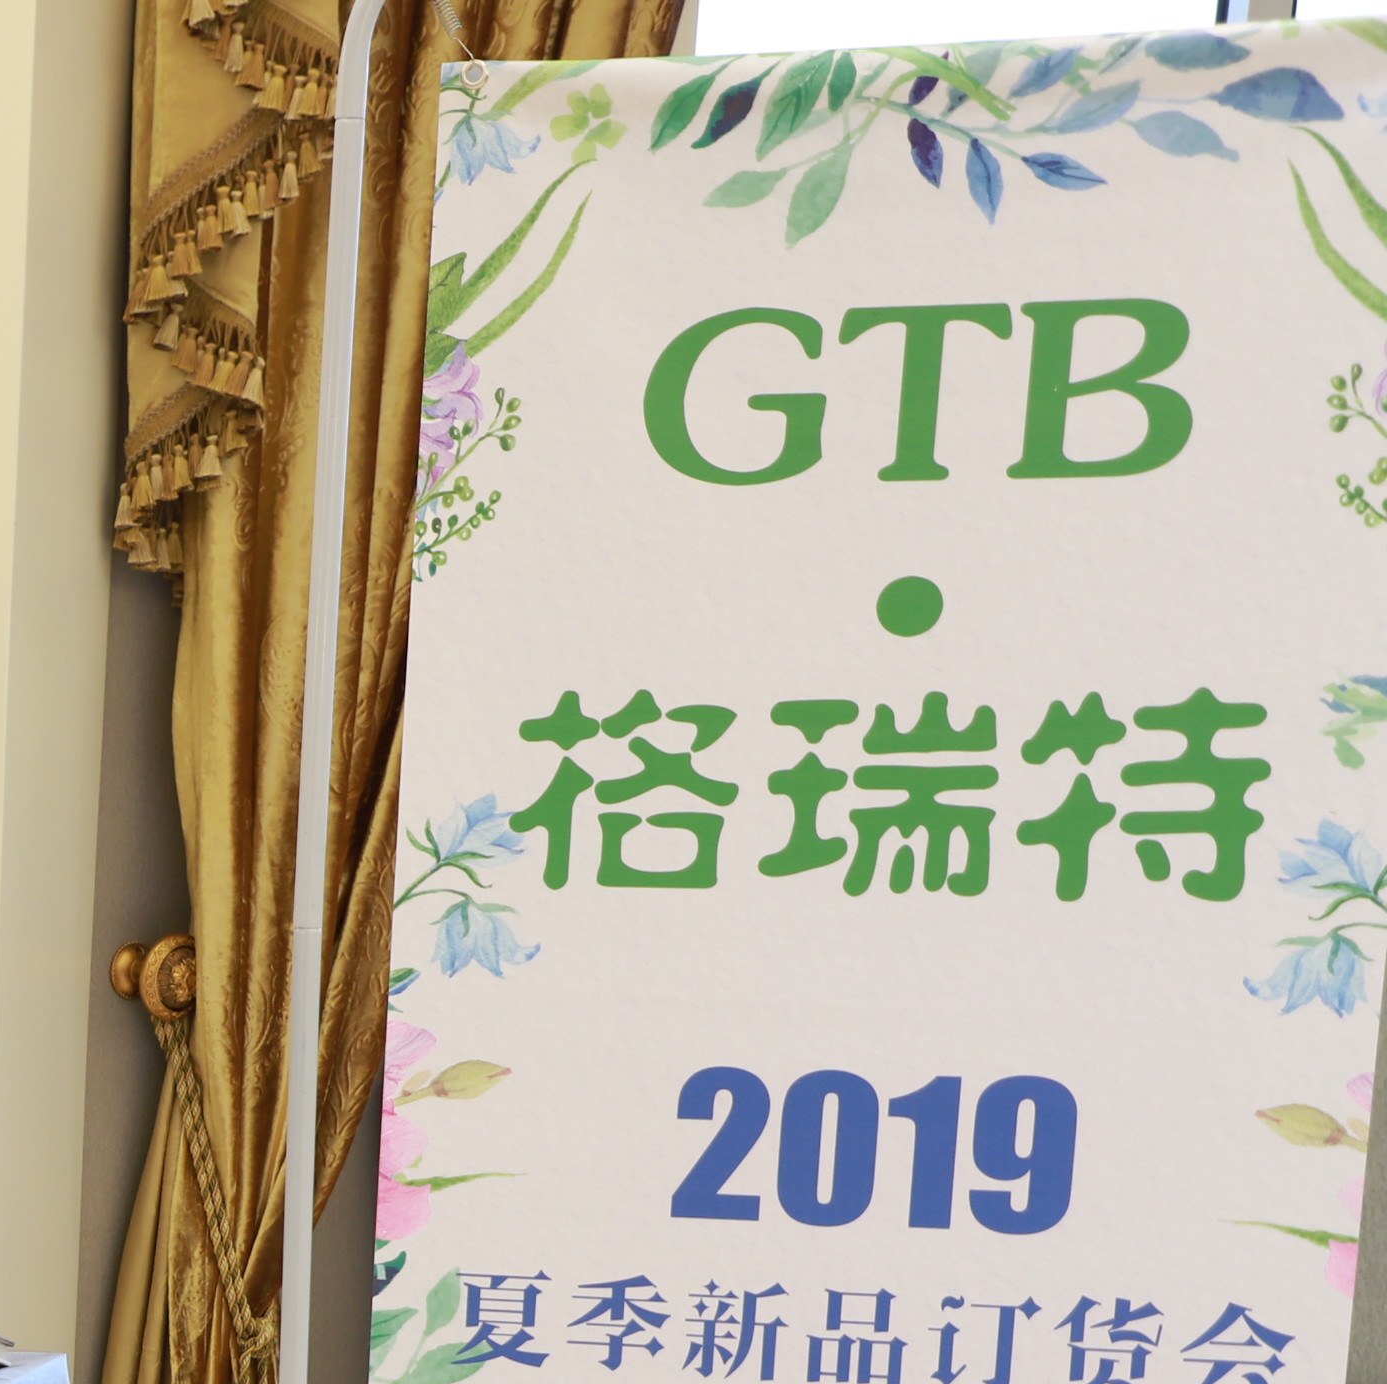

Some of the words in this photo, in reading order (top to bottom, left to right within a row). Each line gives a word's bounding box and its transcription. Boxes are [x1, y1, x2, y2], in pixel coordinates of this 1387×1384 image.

[643, 297, 1193, 486] GTB
[509, 687, 1271, 902] 格瑞特
[670, 1066, 1078, 1235] 2019
